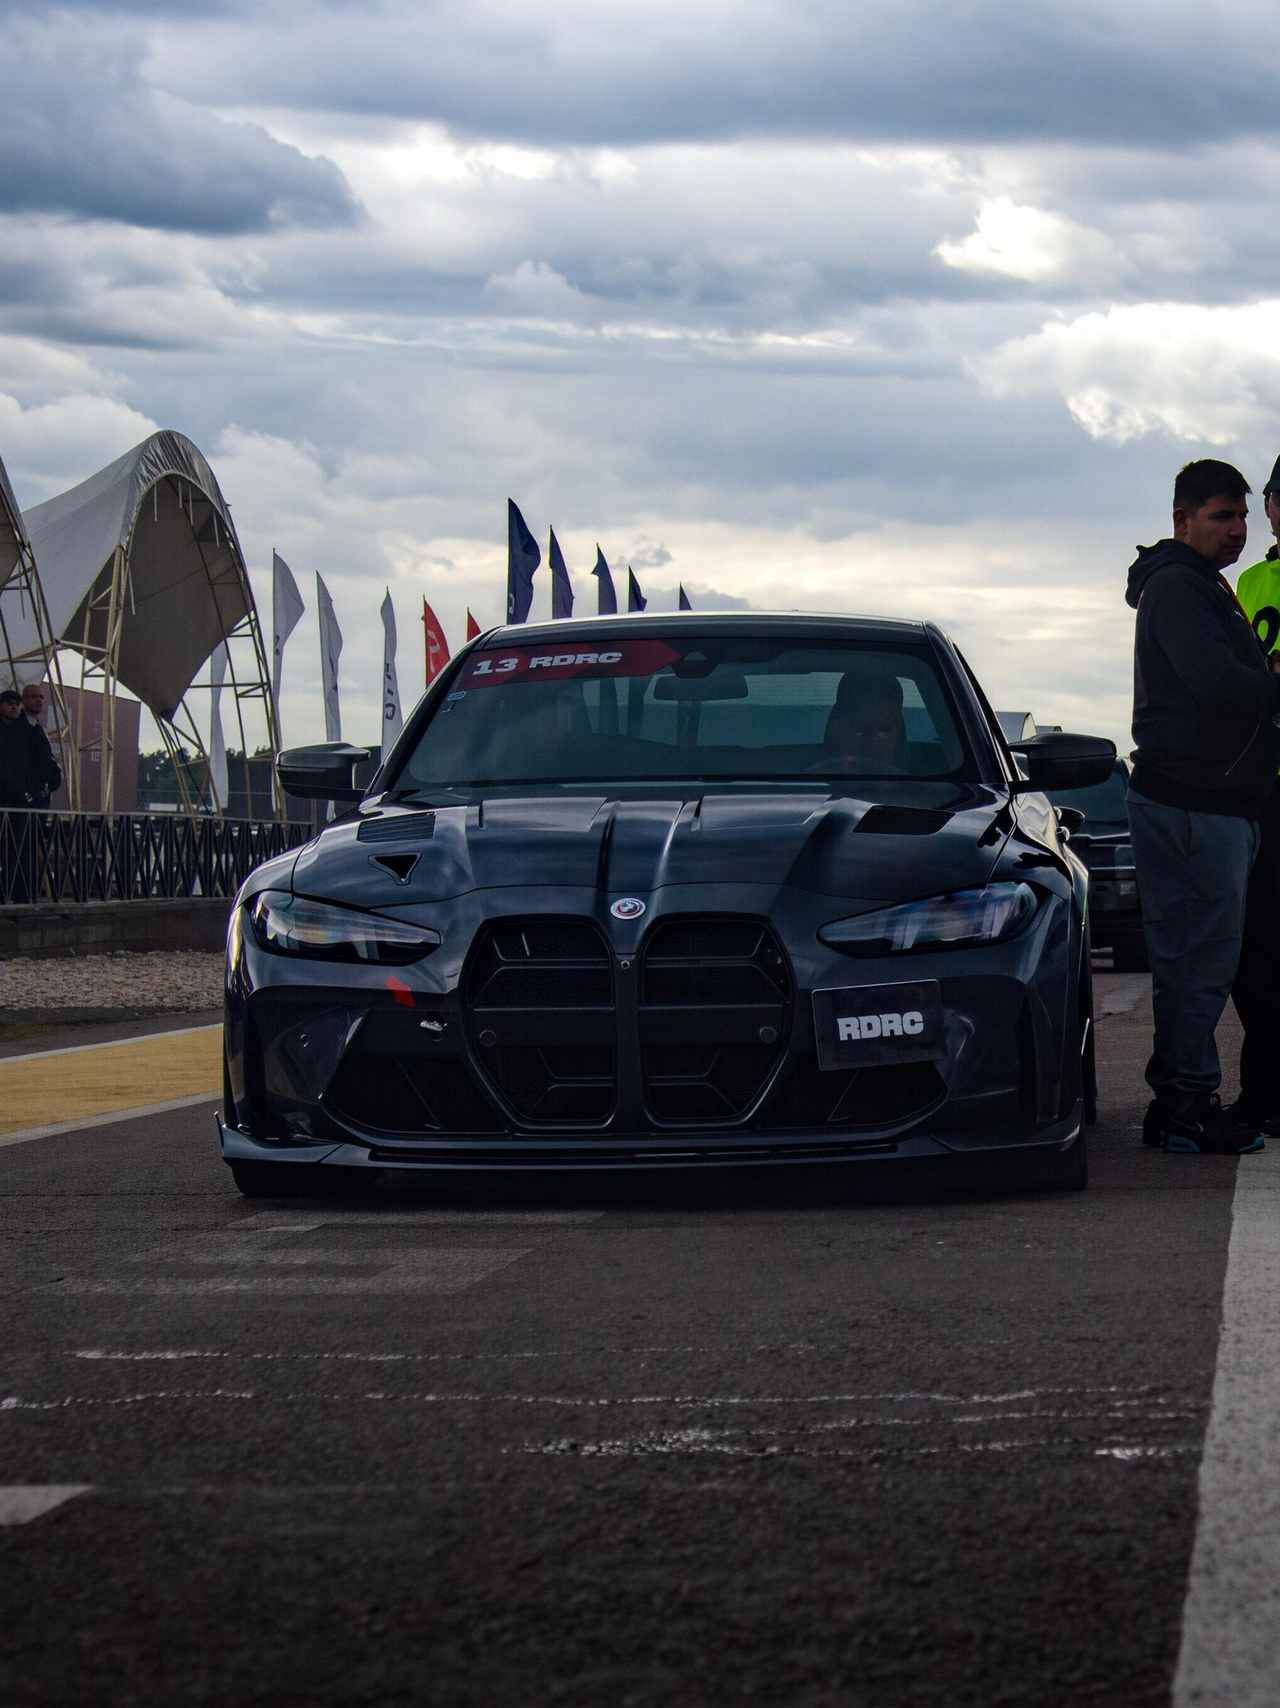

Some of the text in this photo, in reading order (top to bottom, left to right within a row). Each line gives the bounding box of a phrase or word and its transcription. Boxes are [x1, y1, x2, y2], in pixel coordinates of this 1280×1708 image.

[473, 652, 623, 676] 13 RDRC
[836, 1010, 924, 1041] RDRC
